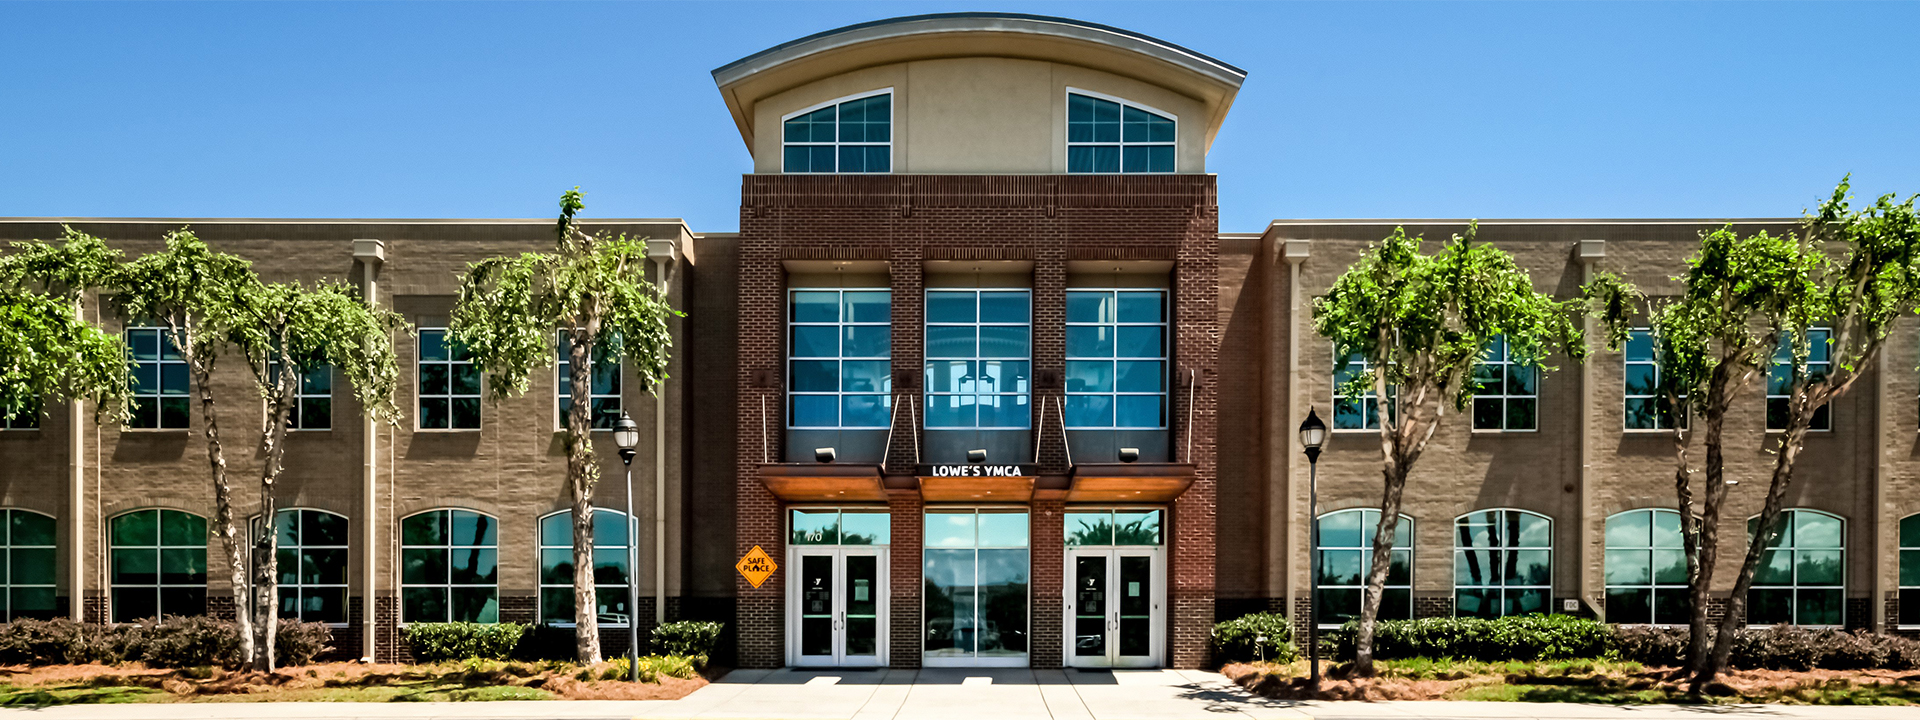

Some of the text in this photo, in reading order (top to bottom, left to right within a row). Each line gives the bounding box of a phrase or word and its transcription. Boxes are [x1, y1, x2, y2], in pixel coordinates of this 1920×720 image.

[932, 465, 1022, 477] LOWE'S YMCA
[747, 557, 765, 565] SAFE
